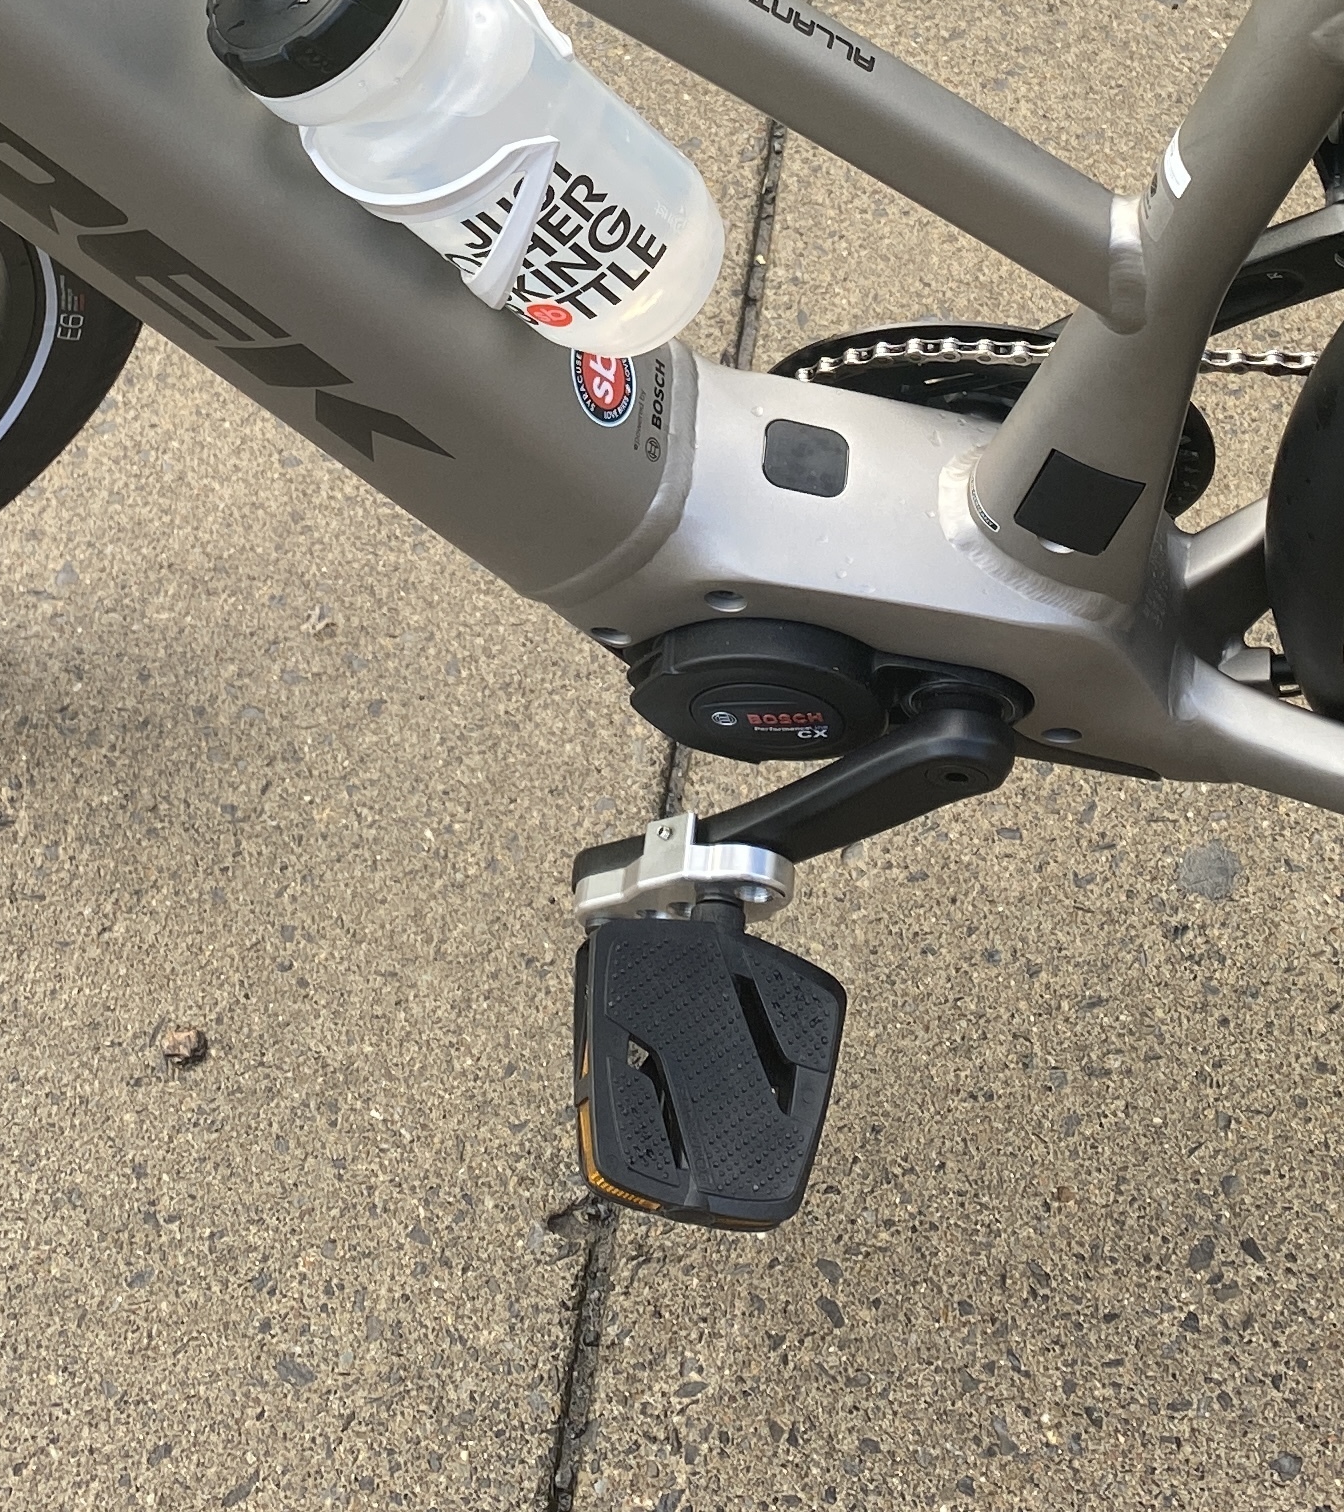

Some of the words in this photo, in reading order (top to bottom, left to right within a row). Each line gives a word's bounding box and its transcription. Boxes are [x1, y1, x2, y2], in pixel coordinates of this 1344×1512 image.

[56, 313, 85, 341] E6
[575, 350, 596, 412] SYRACUSE
[651, 358, 666, 430] BOSCH
[746, 713, 824, 725] BOSCH
[797, 729, 828, 739] CX
